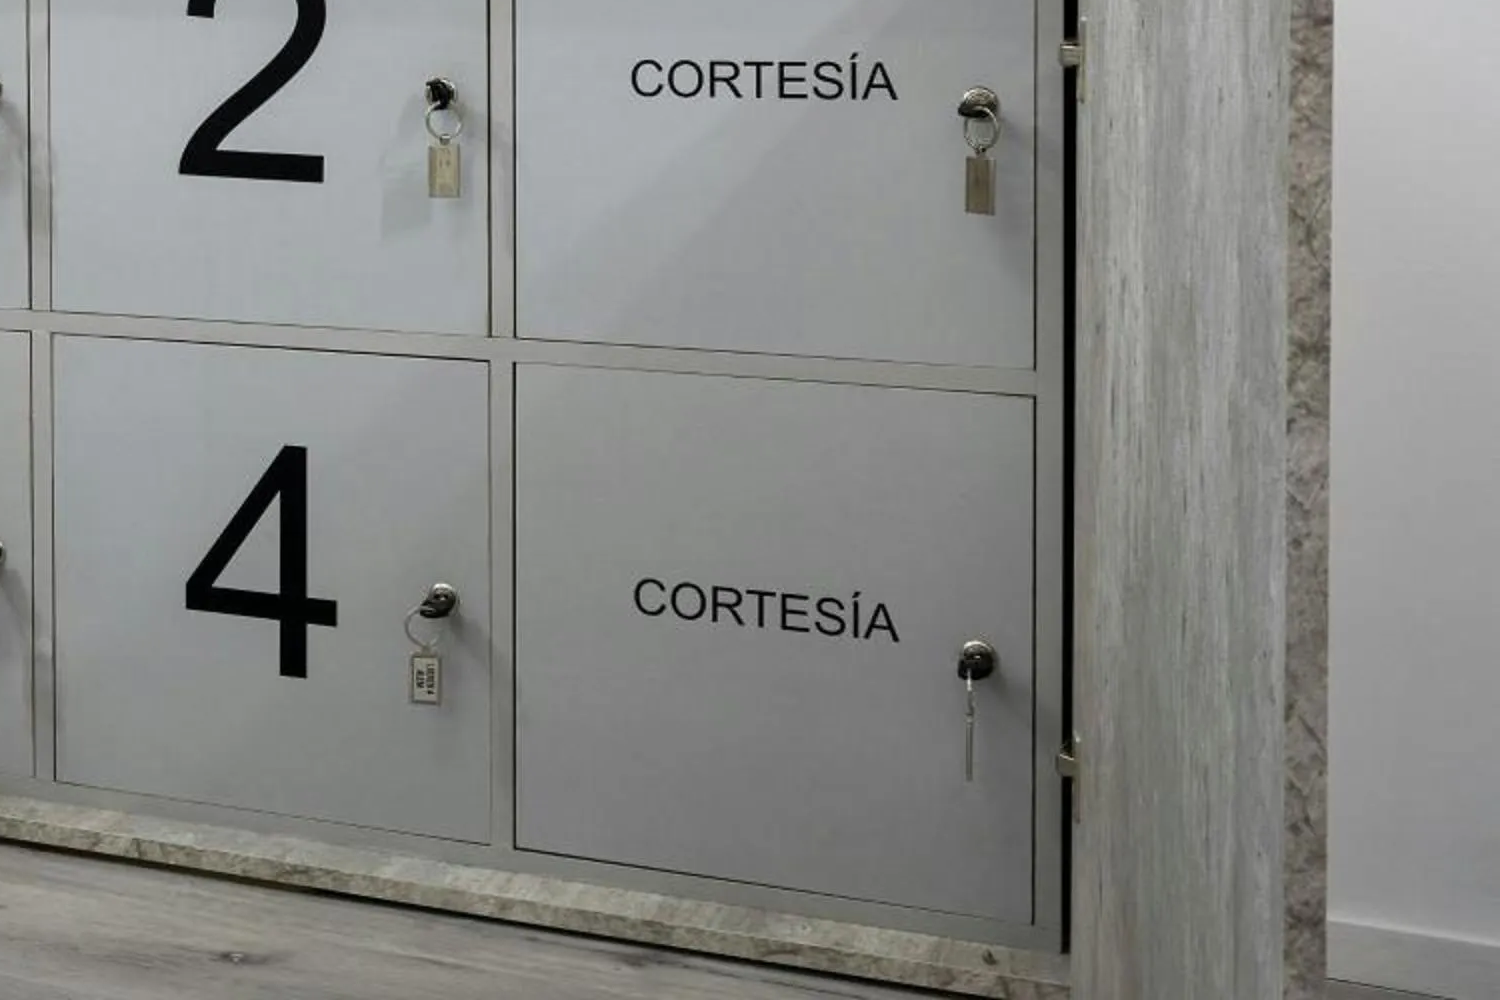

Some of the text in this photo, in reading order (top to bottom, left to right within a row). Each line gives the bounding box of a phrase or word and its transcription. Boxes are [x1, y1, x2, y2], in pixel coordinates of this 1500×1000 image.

[631, 53, 898, 100] CORTESÍA
[186, 445, 338, 679] 4
[634, 578, 900, 643] CORTESÍA
